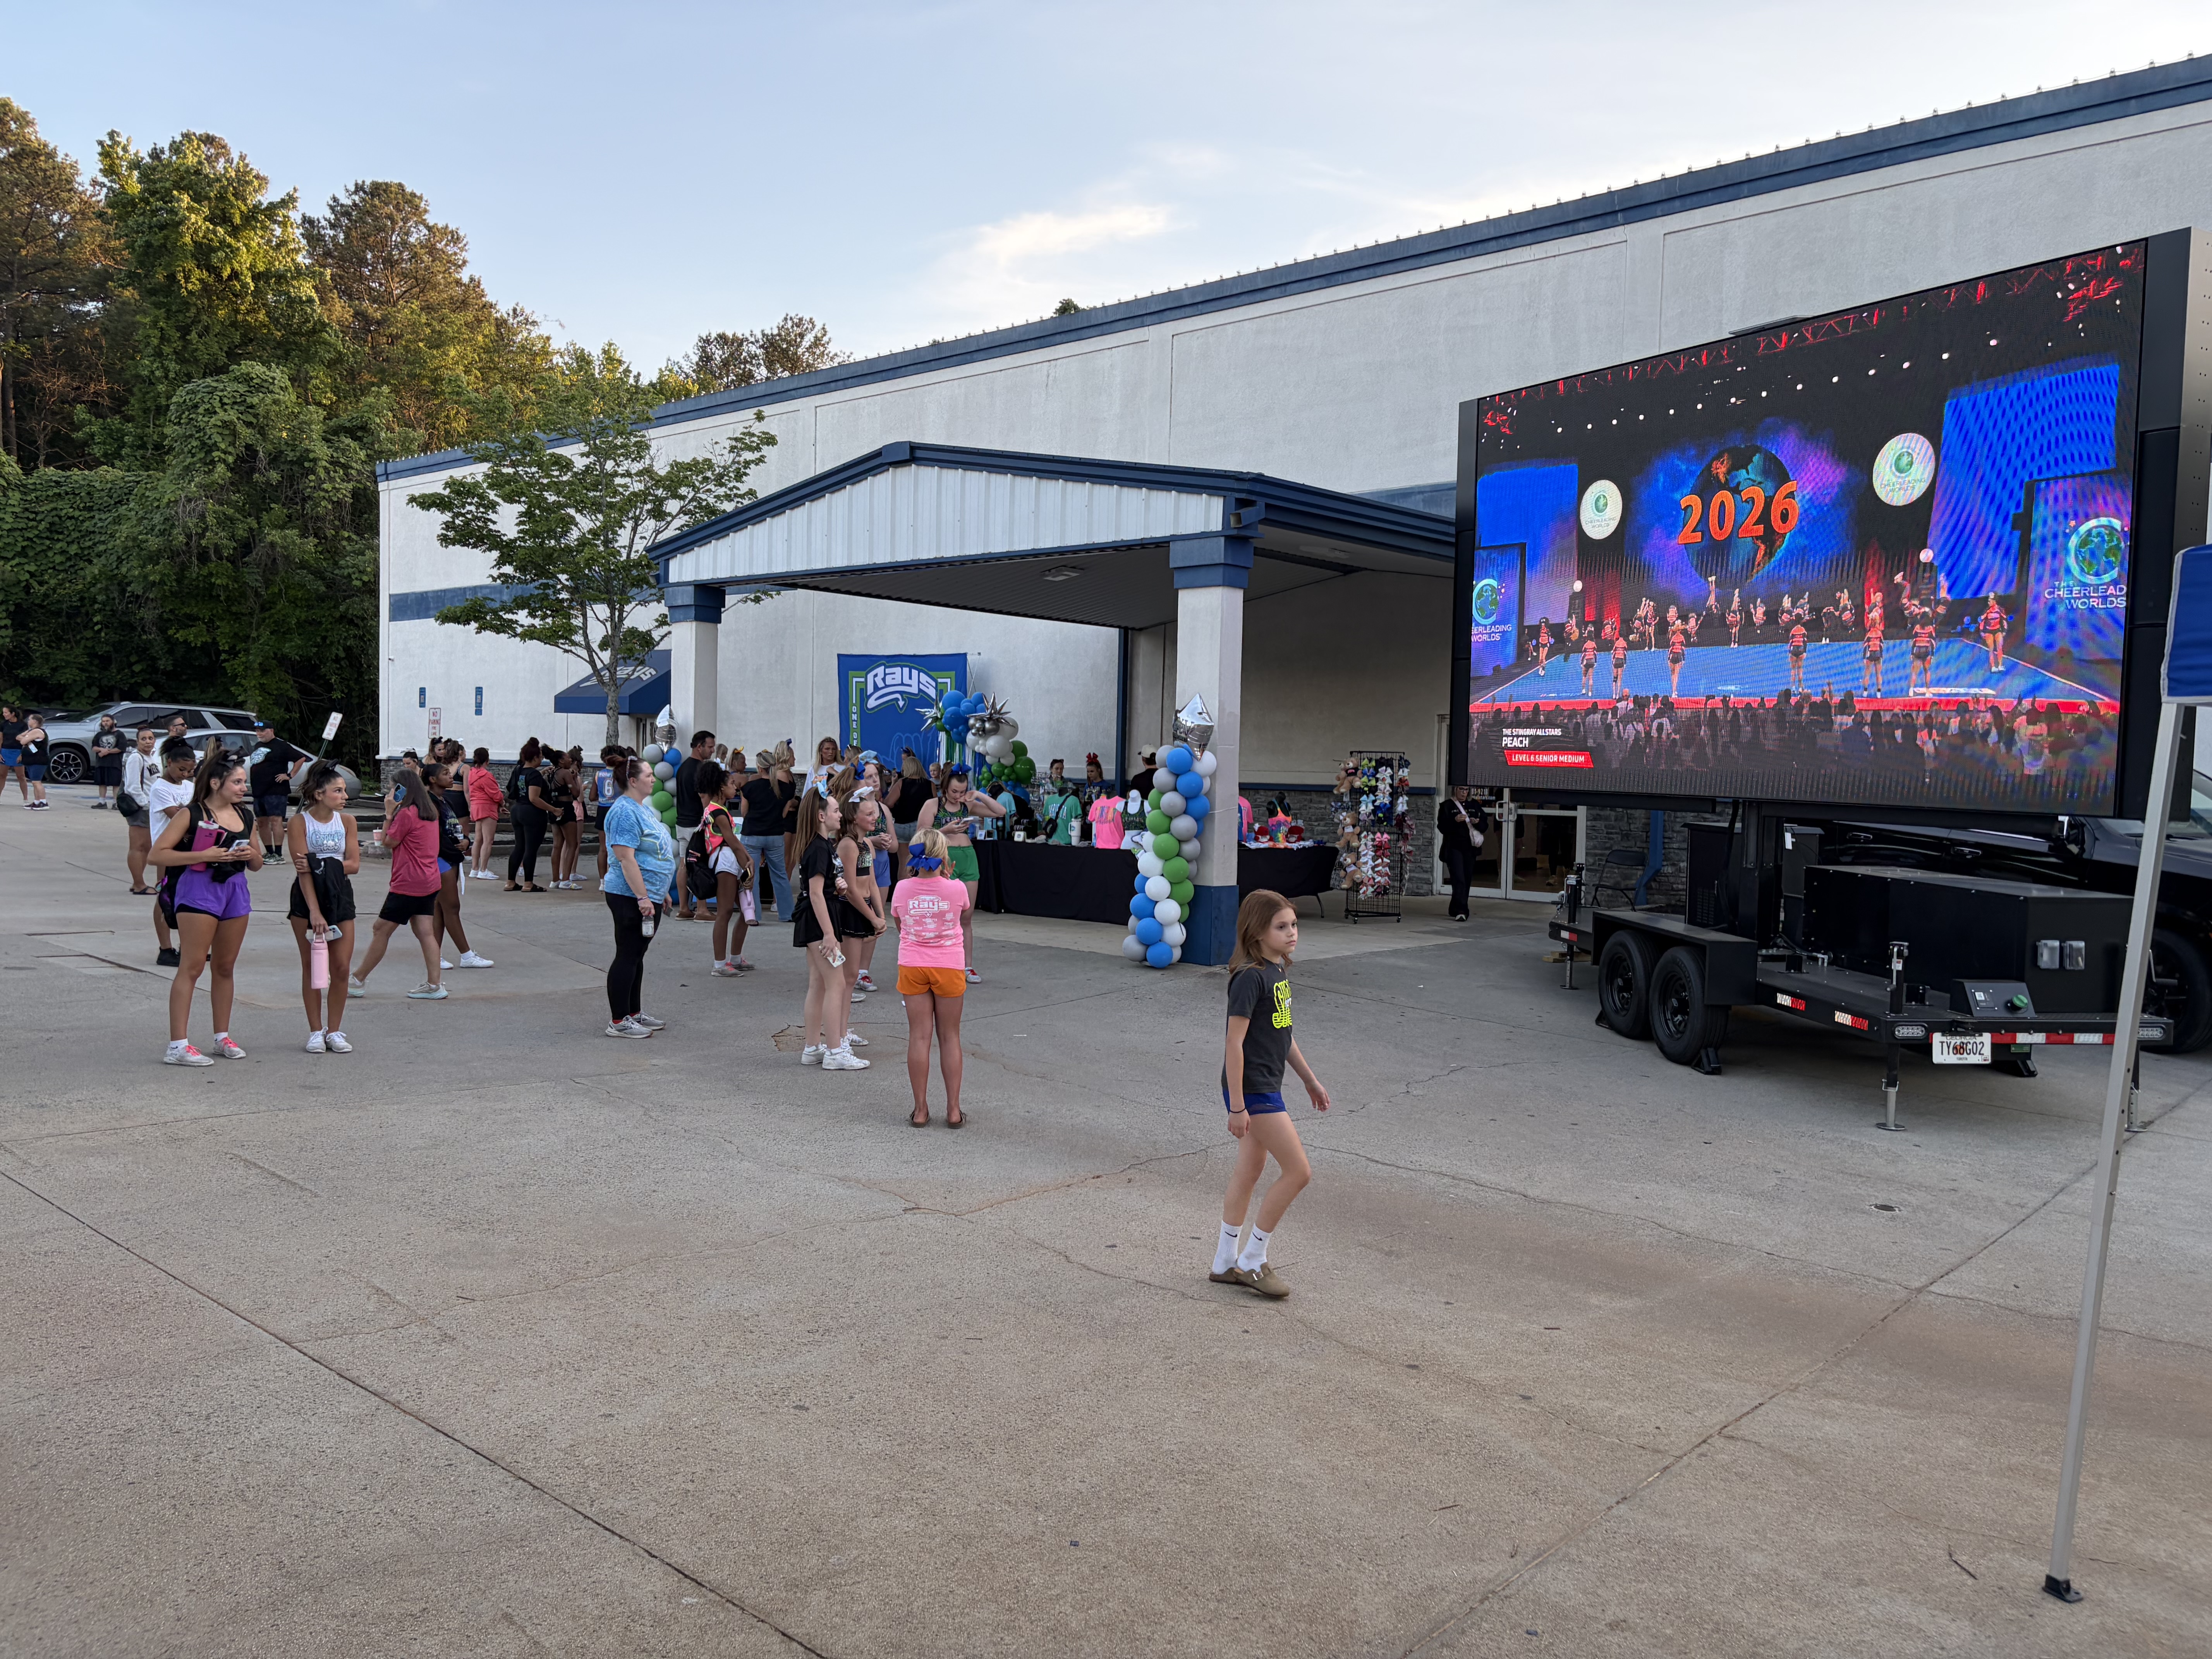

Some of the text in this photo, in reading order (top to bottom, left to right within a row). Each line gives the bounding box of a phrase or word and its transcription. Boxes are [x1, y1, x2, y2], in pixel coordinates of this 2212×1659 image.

[1678, 480, 1799, 544] 2026
[2045, 585, 2127, 598] CHEERLEAD
[2065, 597, 2126, 609] WORLDS
[867, 665, 936, 702] Rays
[1502, 737, 1528, 747] PEACH
[909, 900, 948, 912] Rays
